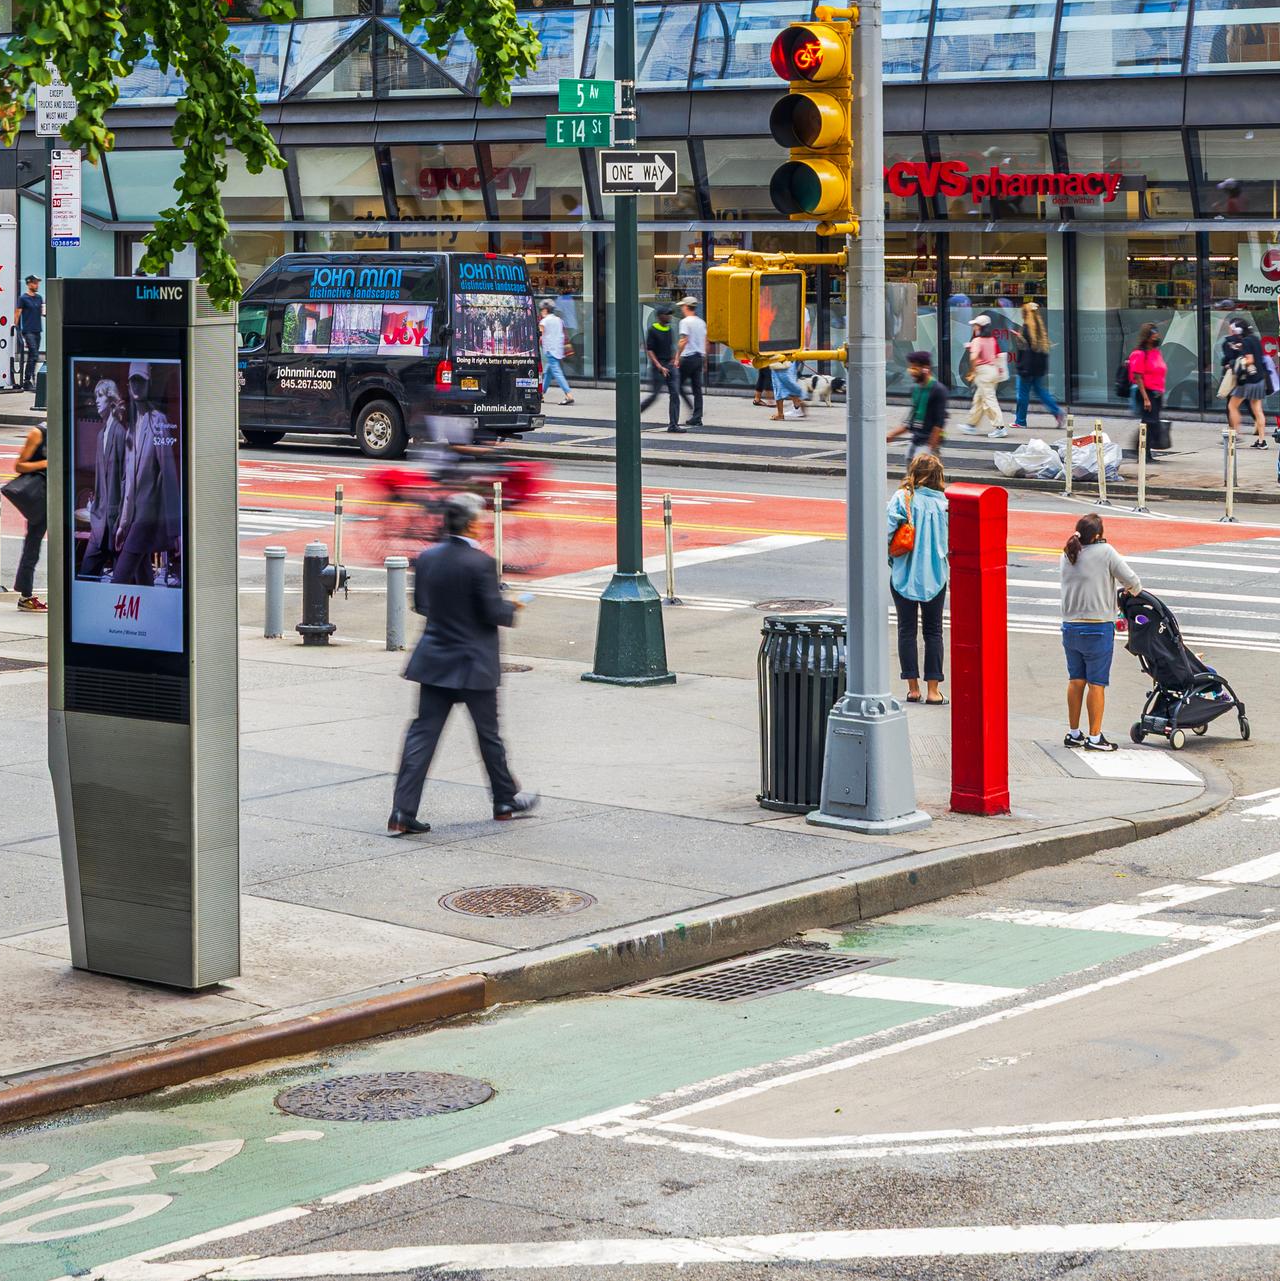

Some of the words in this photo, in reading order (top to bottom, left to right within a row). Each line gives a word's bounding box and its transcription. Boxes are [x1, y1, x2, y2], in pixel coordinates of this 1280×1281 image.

[577, 84, 584, 108] 5
[590, 84, 599, 99] Av
[557, 120, 564, 143] E
[571, 120, 586, 143] 14
[592, 119, 602, 134] St
[612, 165, 633, 181] ONE
[643, 165, 665, 181] WAY
[887, 160, 969, 197] CVS
[971, 166, 1121, 203] pharmacy
[136, 285, 183, 300] LinkNYC
[309, 287, 351, 299] distinctive
[353, 287, 400, 300] landscapes
[460, 280, 494, 291] distinctive
[495, 280, 527, 293] landscapes
[456, 357, 471, 365] Doing
[276, 366, 336, 381] johnmini.com
[281, 380, 332, 390] 845.267.5300
[473, 404, 523, 413] johnmini.com
[114, 594, 140, 621] H&M
